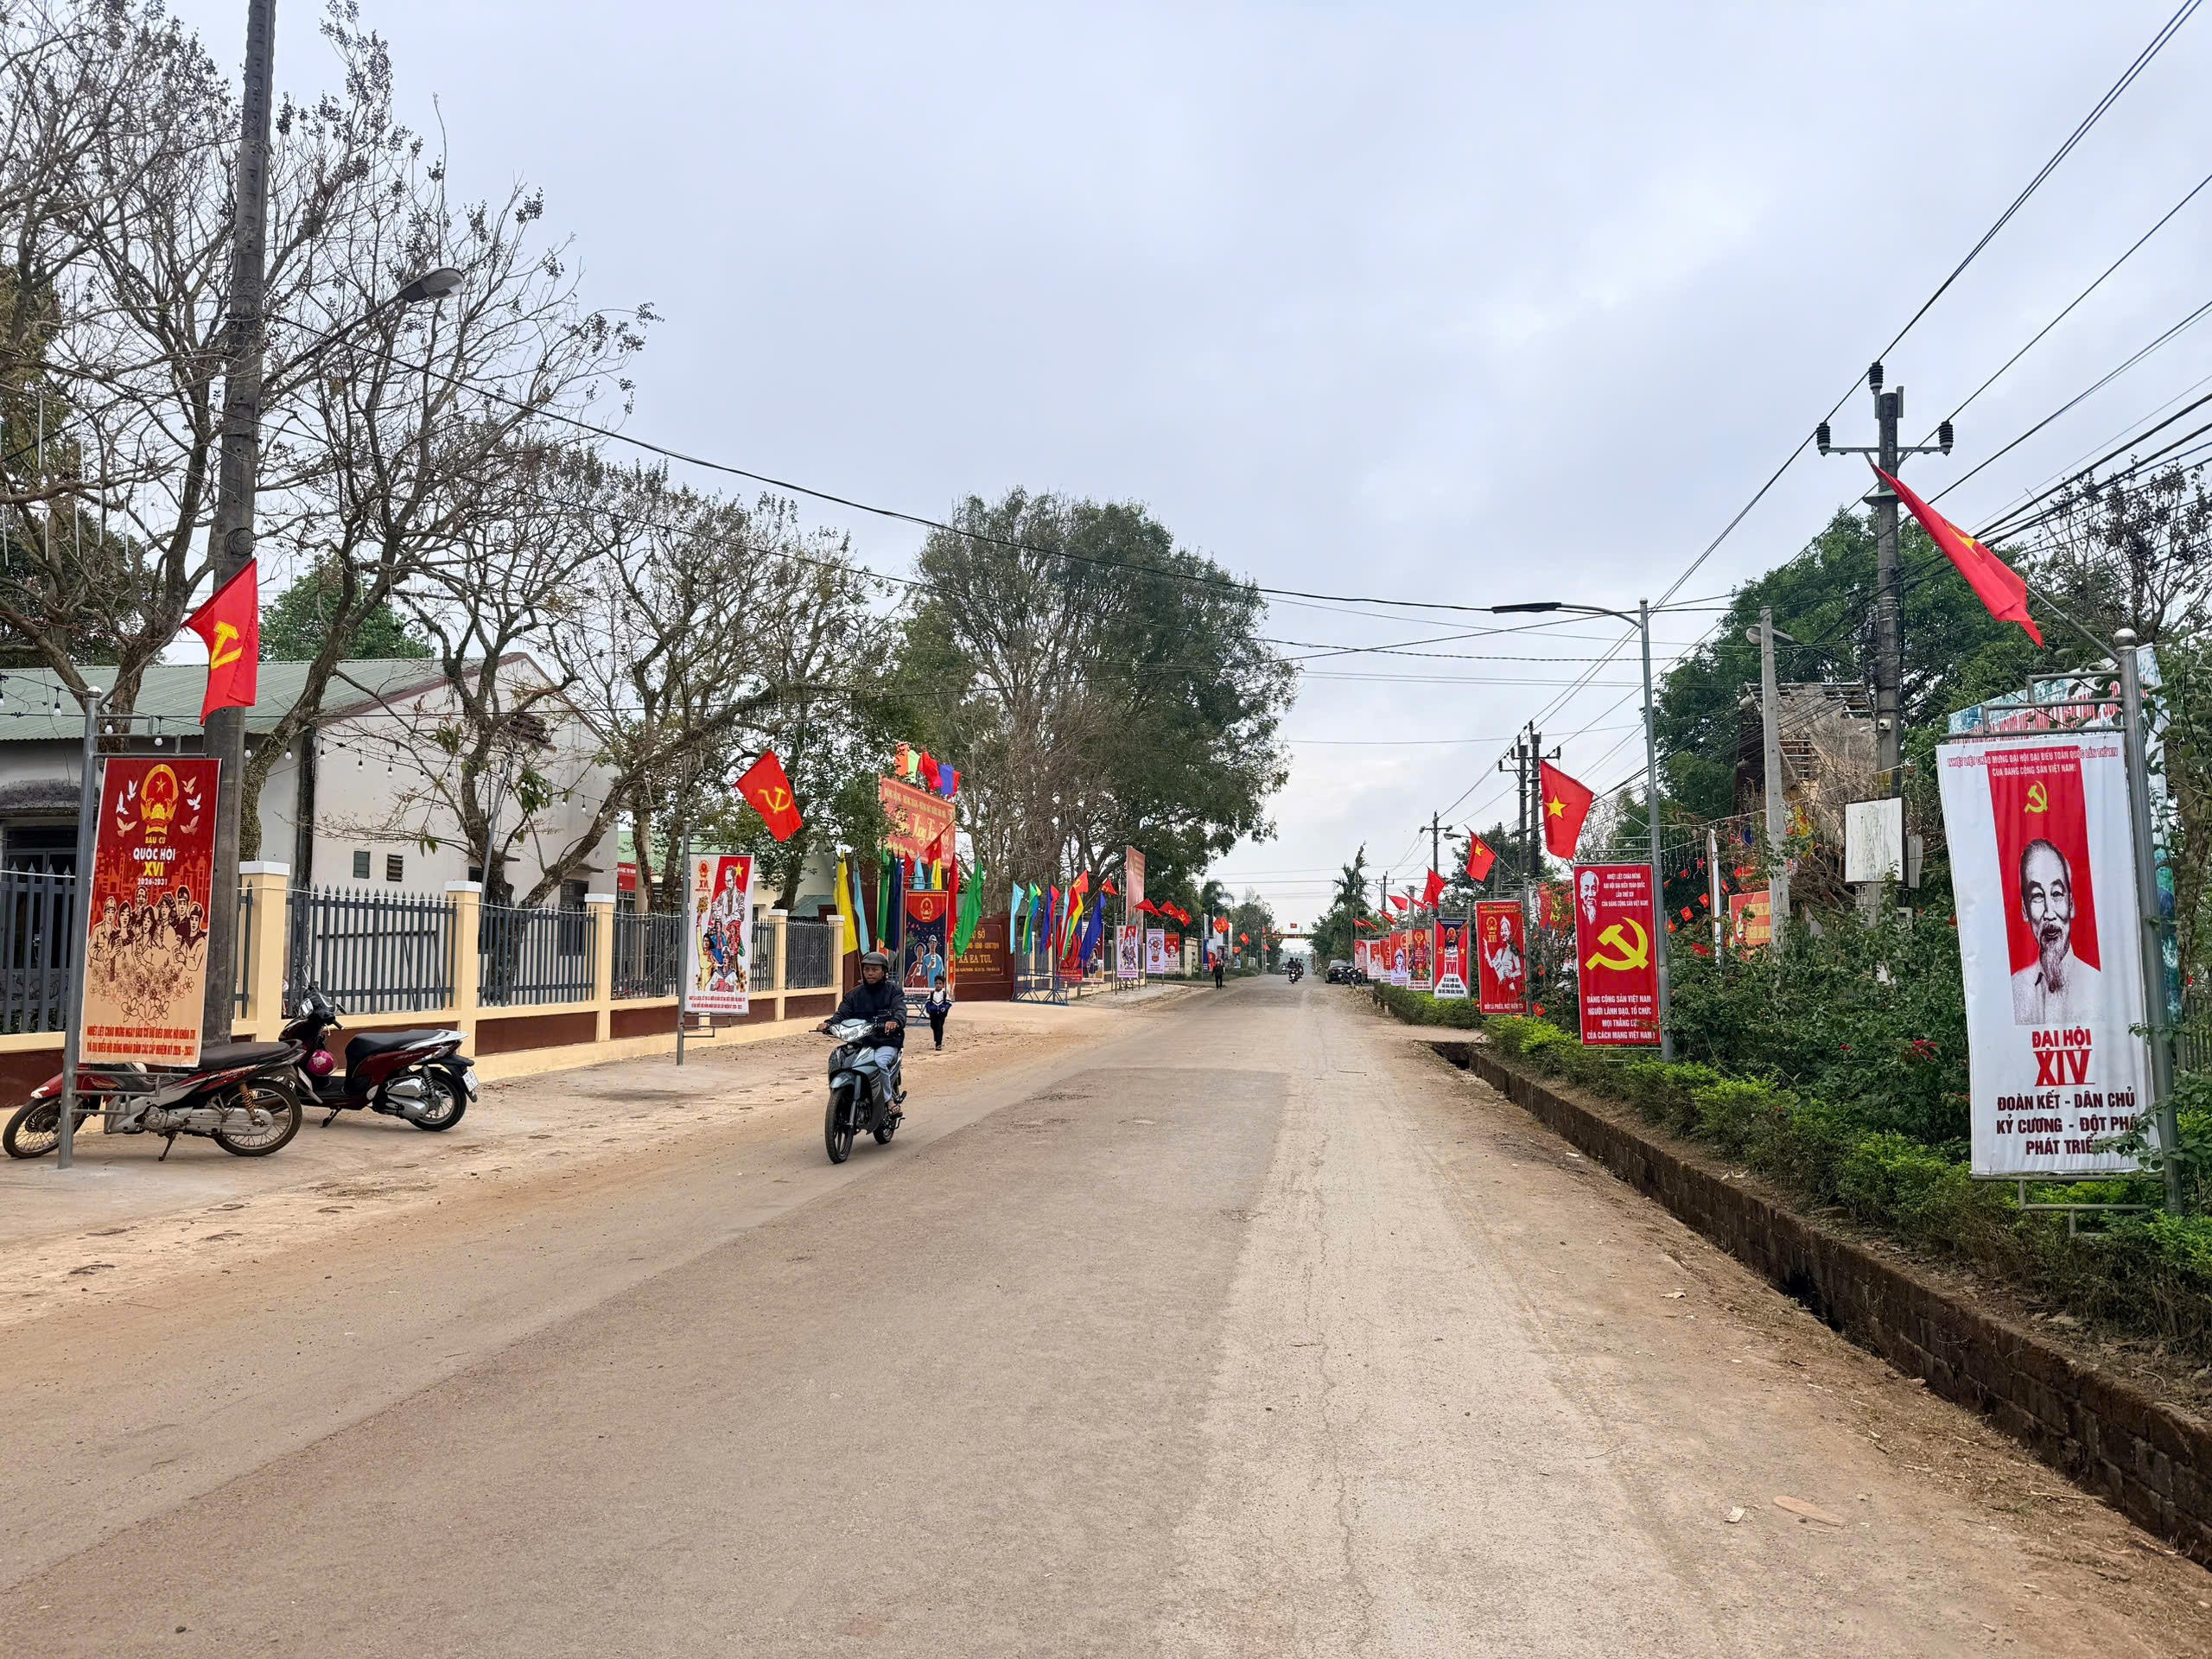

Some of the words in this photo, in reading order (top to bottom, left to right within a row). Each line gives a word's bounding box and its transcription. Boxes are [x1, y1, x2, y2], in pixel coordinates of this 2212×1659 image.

[133, 843, 158, 861] QUỐC
[160, 845, 176, 864] HỘI
[143, 861, 164, 877] XVI
[969, 954, 979, 963] EA
[980, 954, 992, 963] TUL
[1446, 961, 1457, 974] XVI
[1586, 993, 1600, 1003] ĐẢNG
[1601, 994, 1616, 1004] CỘNG
[1616, 993, 1627, 1003] SẢN
[1628, 994, 1638, 1004] VIỆT
[1639, 995, 1651, 1003] NAM
[1587, 1029, 1597, 1039] CỦA
[1597, 1030, 1611, 1039] CÁCH
[1611, 1031, 1628, 1040] MẠNG
[1628, 1029, 1639, 1040] VIỆT
[2032, 1030, 2059, 1051] ĐẠI
[2063, 1026, 2092, 1049] HỘI
[2033, 1048, 2095, 1087] XIV
[1997, 1092, 2034, 1111] ĐOÀN
[2037, 1090, 2061, 1109] KẾT
[2074, 1090, 2103, 1108] DÂN
[2107, 1086, 2135, 1107] CHỦ
[1996, 1113, 2014, 1134] KỶ
[2018, 1116, 2063, 1134] CƯƠNG
[2079, 1114, 2107, 1135] ĐỘT
[2025, 1137, 2060, 1155] PHÁT
[2064, 1134, 2109, 1154] TRIỂ
